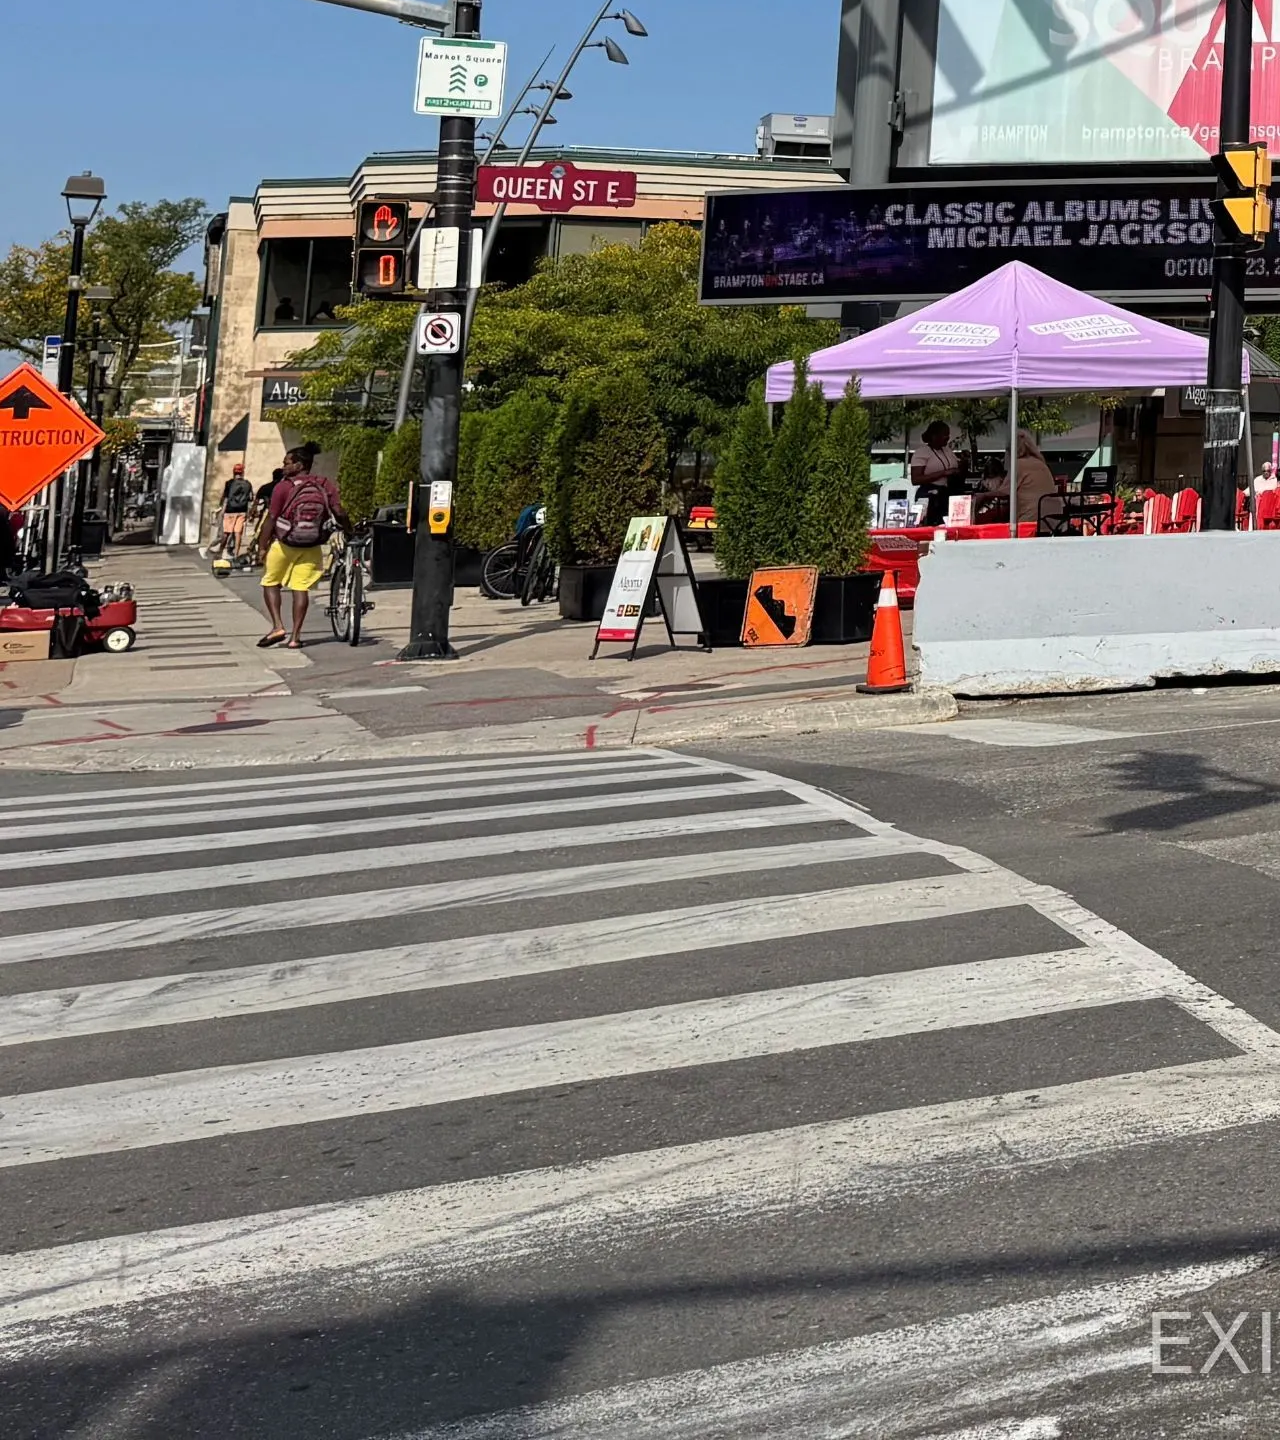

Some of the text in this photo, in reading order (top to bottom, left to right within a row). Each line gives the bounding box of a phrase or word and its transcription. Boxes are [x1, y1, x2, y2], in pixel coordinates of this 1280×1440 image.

[425, 52, 502, 63] Market Square
[470, 100, 491, 109] FREE
[981, 124, 1048, 141] BRAMPTON
[493, 176, 620, 203] QUEEN ST E
[885, 201, 1015, 226] CLASSIC
[1022, 198, 1162, 222] ALBUMS
[1169, 197, 1215, 220] LIV
[927, 225, 1072, 248] MICHAEL
[1078, 221, 1212, 246] JACKSO
[1164, 258, 1213, 276] OCTO
[1185, 386, 1208, 405] Algo
[1, 429, 85, 446] TRUCTION
